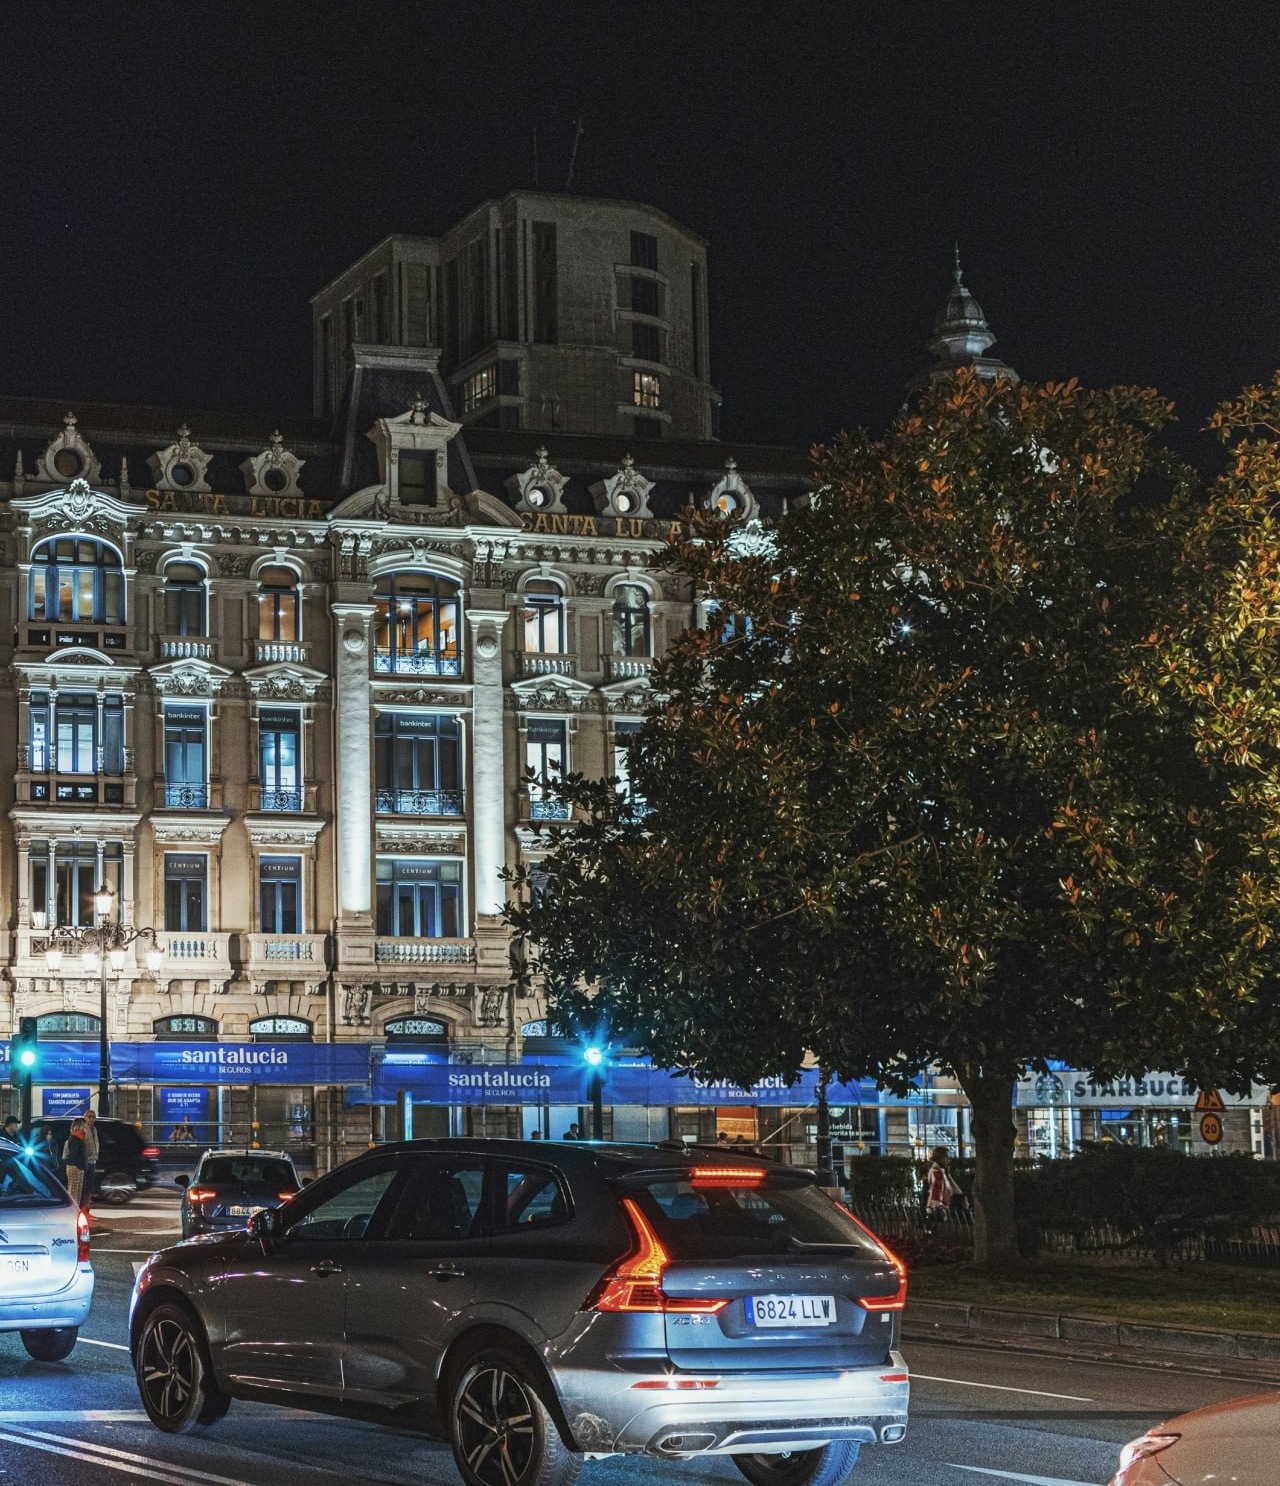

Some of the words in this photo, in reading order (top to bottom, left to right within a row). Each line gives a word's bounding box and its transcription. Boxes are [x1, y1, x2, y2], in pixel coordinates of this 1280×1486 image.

[144, 489, 230, 514] SANTA
[251, 497, 323, 518] LUCIA
[521, 512, 598, 535] SANTA
[167, 712, 200, 720] bankinter
[400, 720, 432, 728] bankinter
[181, 1048, 288, 1064] santalucía
[218, 1066, 251, 1074] SEGUROS
[448, 1071, 551, 1087] santalucía
[484, 1089, 516, 1097] SEGUROS
[1205, 1123, 1217, 1135] 20
[756, 1300, 797, 1319] 6824
[802, 1300, 830, 1318] LLW
